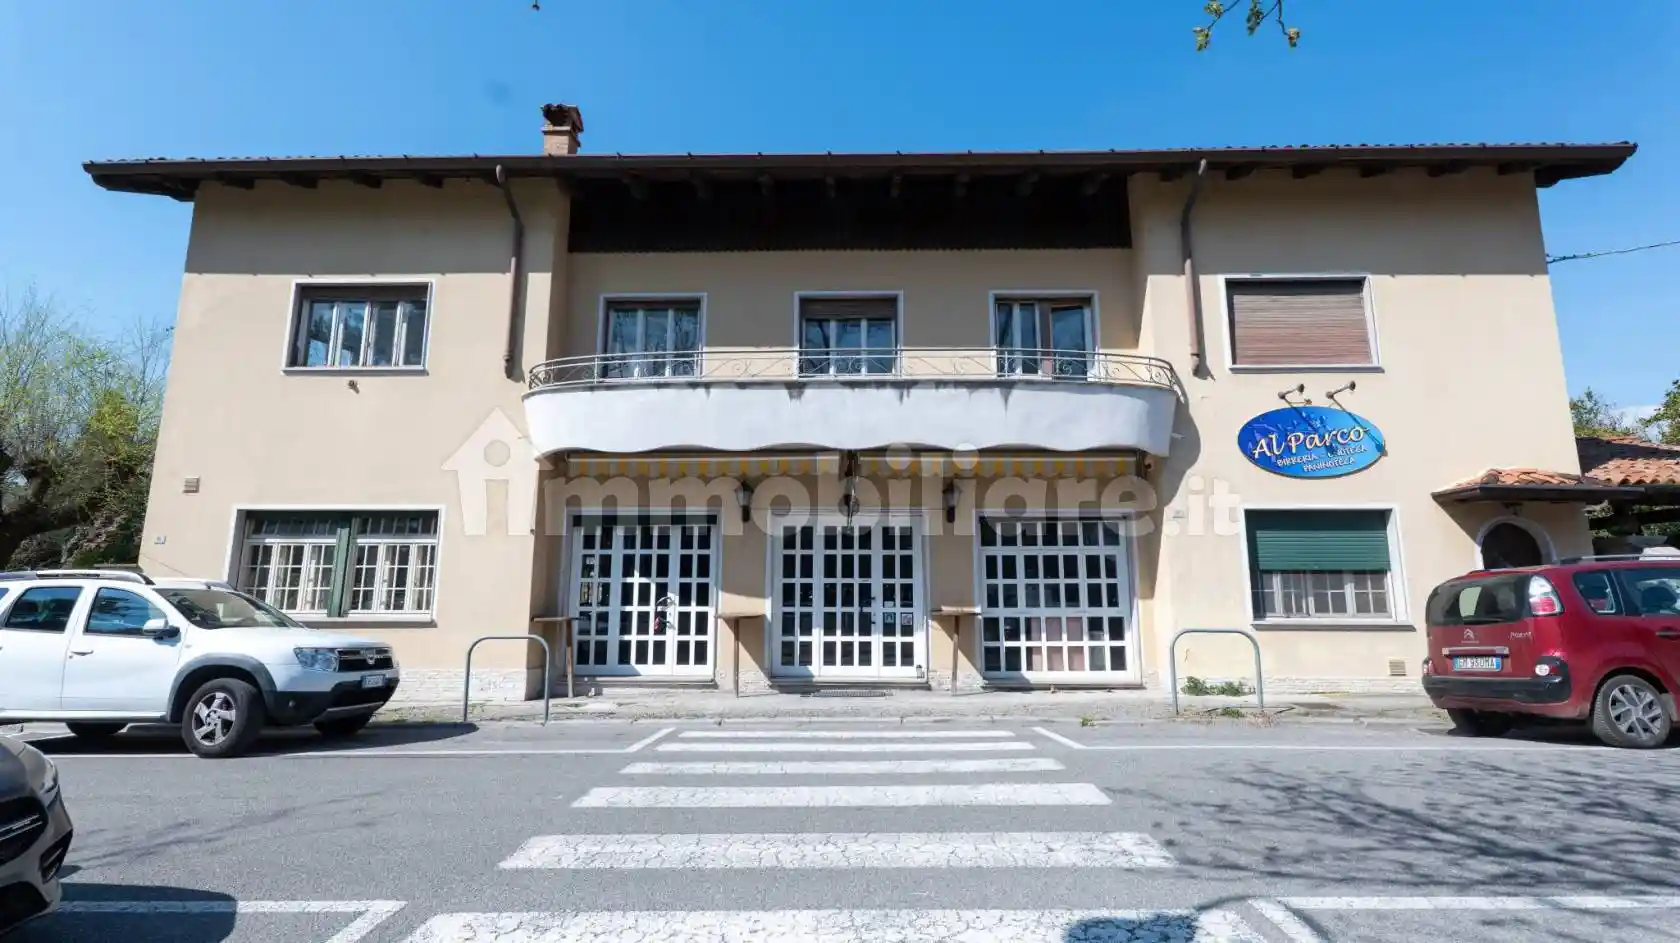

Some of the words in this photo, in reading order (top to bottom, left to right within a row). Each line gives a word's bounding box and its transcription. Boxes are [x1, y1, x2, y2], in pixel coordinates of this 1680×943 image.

[1253, 432, 1284, 458] Al
[1287, 425, 1368, 454] Parco
[1277, 454, 1318, 466] BIRRERIA
[1303, 457, 1355, 472] PANINOTECA
